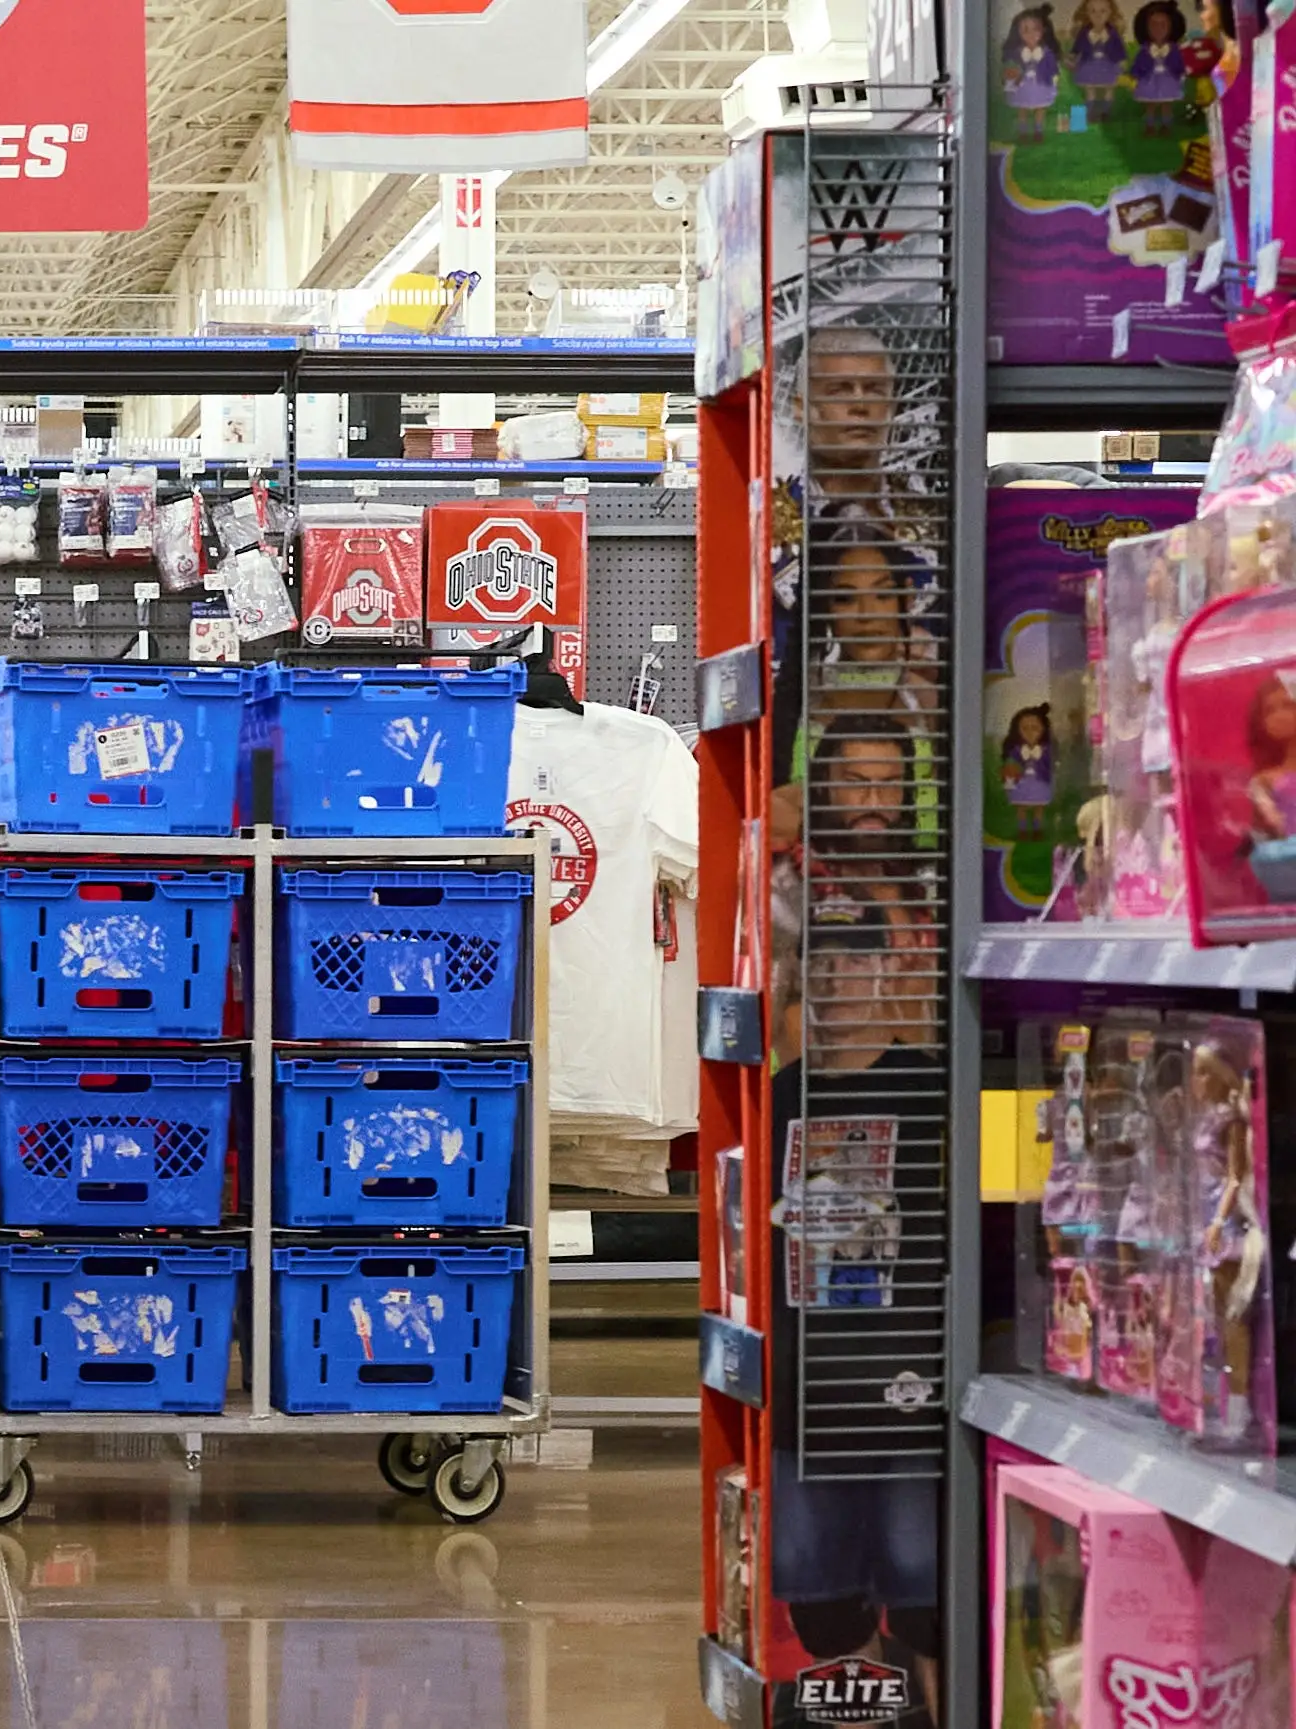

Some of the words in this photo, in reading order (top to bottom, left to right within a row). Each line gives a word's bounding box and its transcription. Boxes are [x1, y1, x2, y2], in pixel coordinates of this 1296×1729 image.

[340, 335, 356, 344] Ask
[357, 335, 370, 344] for
[372, 336, 412, 346] assistance
[414, 337, 432, 346] with
[432, 338, 455, 346] items
[469, 338, 484, 347] the
[484, 340, 500, 350] top
[448, 552, 494, 609] OHIO
[496, 546, 554, 610] STATE
[332, 587, 360, 622] OHIO
[360, 582, 396, 621] STATE
[548, 804, 594, 850] UNIVERSITY
[801, 1680, 904, 1703] ELITE
[810, 1709, 894, 1718] COLLECTION
